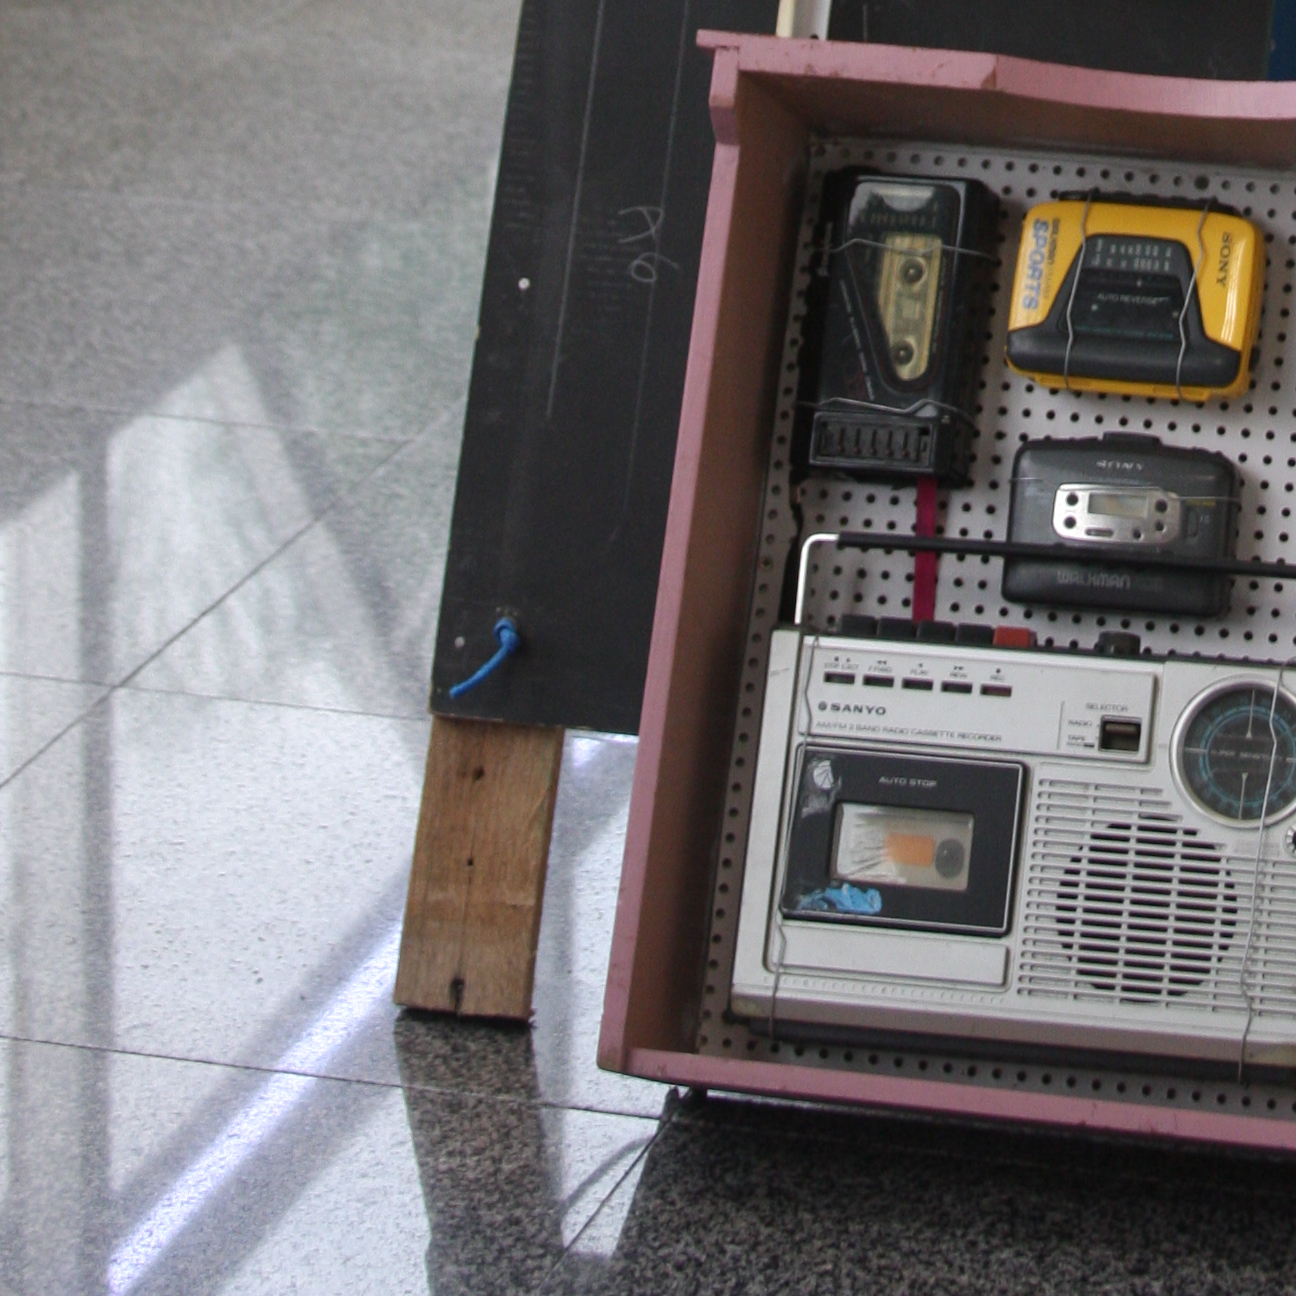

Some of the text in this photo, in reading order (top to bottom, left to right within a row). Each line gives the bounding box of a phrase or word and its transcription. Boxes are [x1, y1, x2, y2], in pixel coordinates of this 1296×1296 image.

[1023, 219, 1049, 311] SPORTS
[1215, 231, 1233, 288] SONY
[1096, 459, 1144, 471] SONY
[1056, 570, 1131, 589] WALKMAN
[830, 702, 887, 716] SANYO
